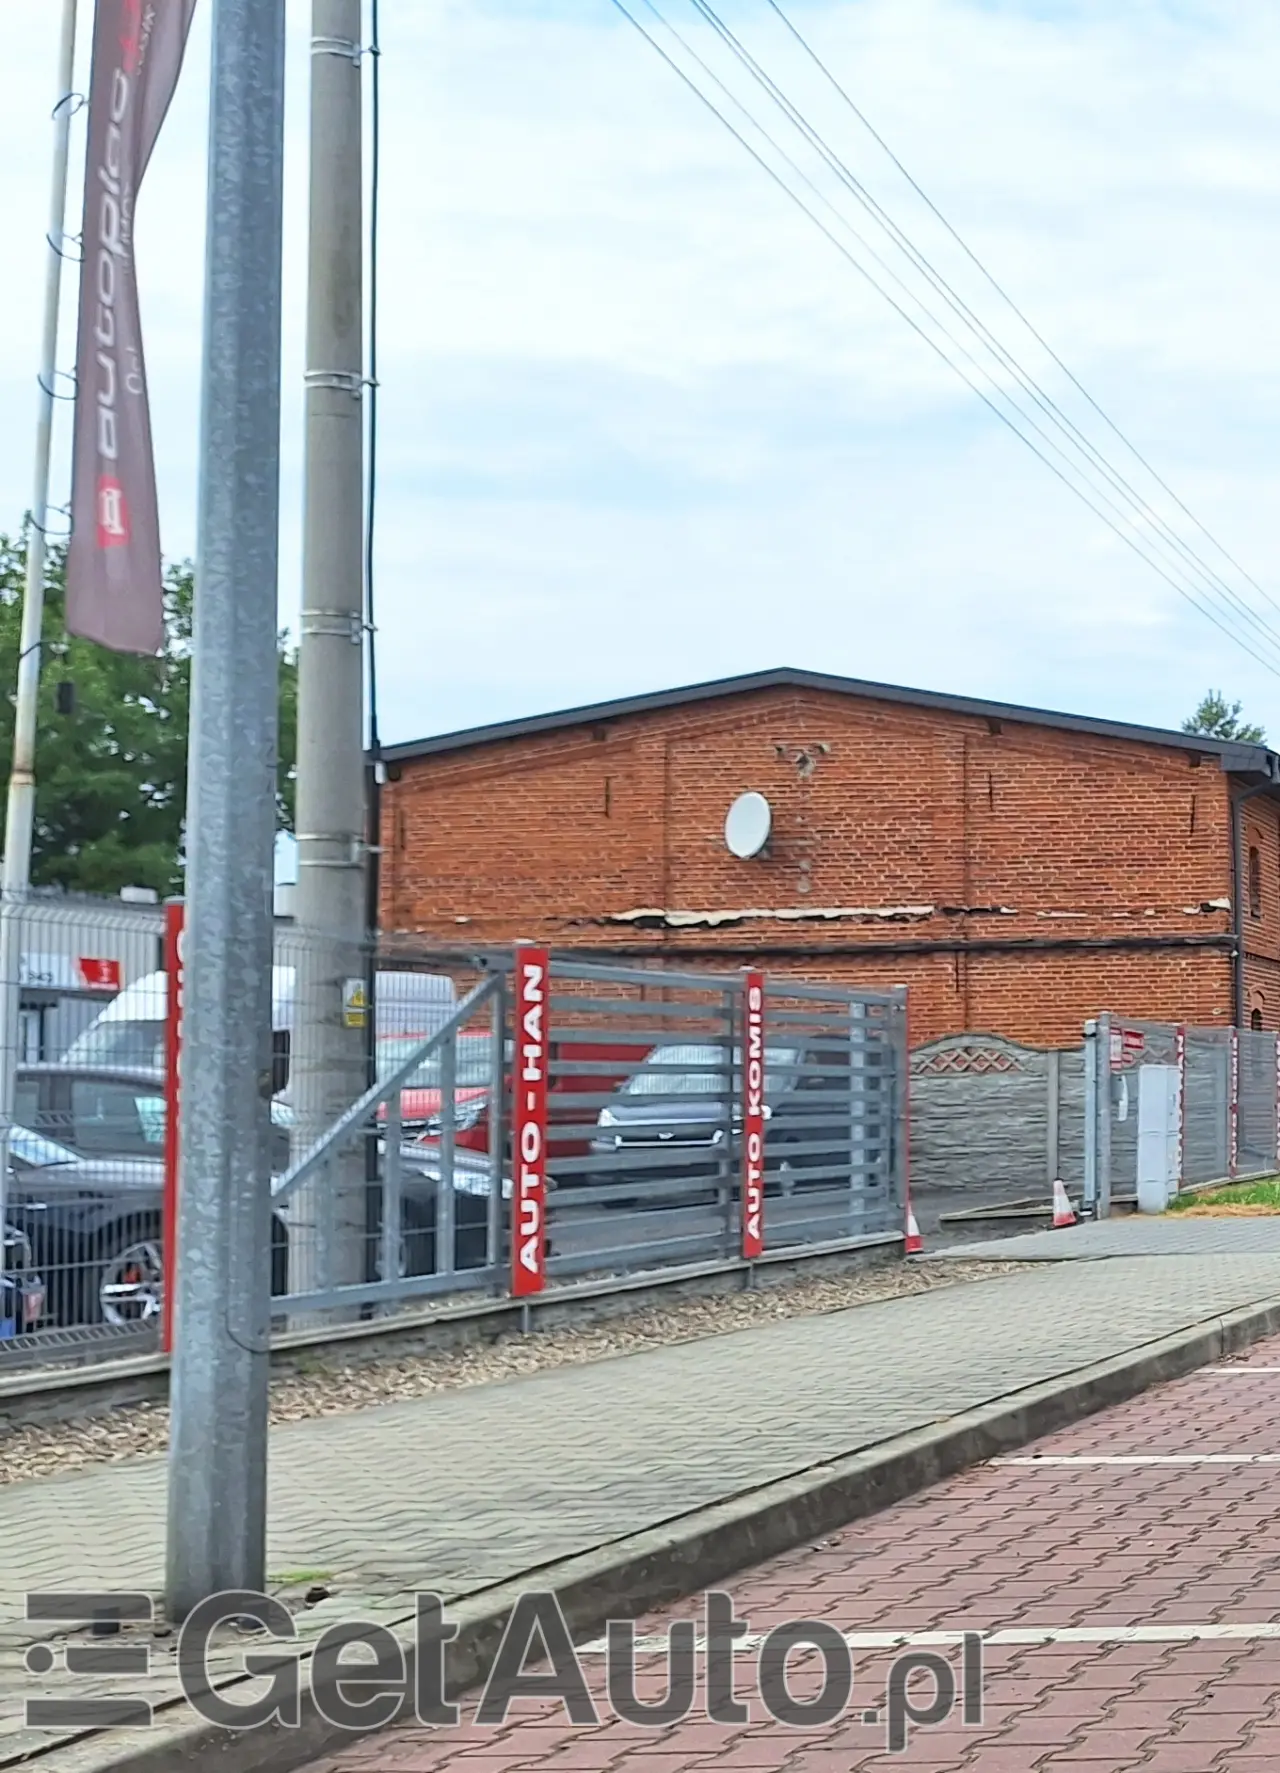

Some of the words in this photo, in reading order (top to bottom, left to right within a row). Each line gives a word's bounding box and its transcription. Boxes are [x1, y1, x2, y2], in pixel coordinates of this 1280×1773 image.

[95, 67, 128, 460] autoplac
[748, 986, 763, 1116] KOMIS
[747, 1132, 761, 1240] AUTO
